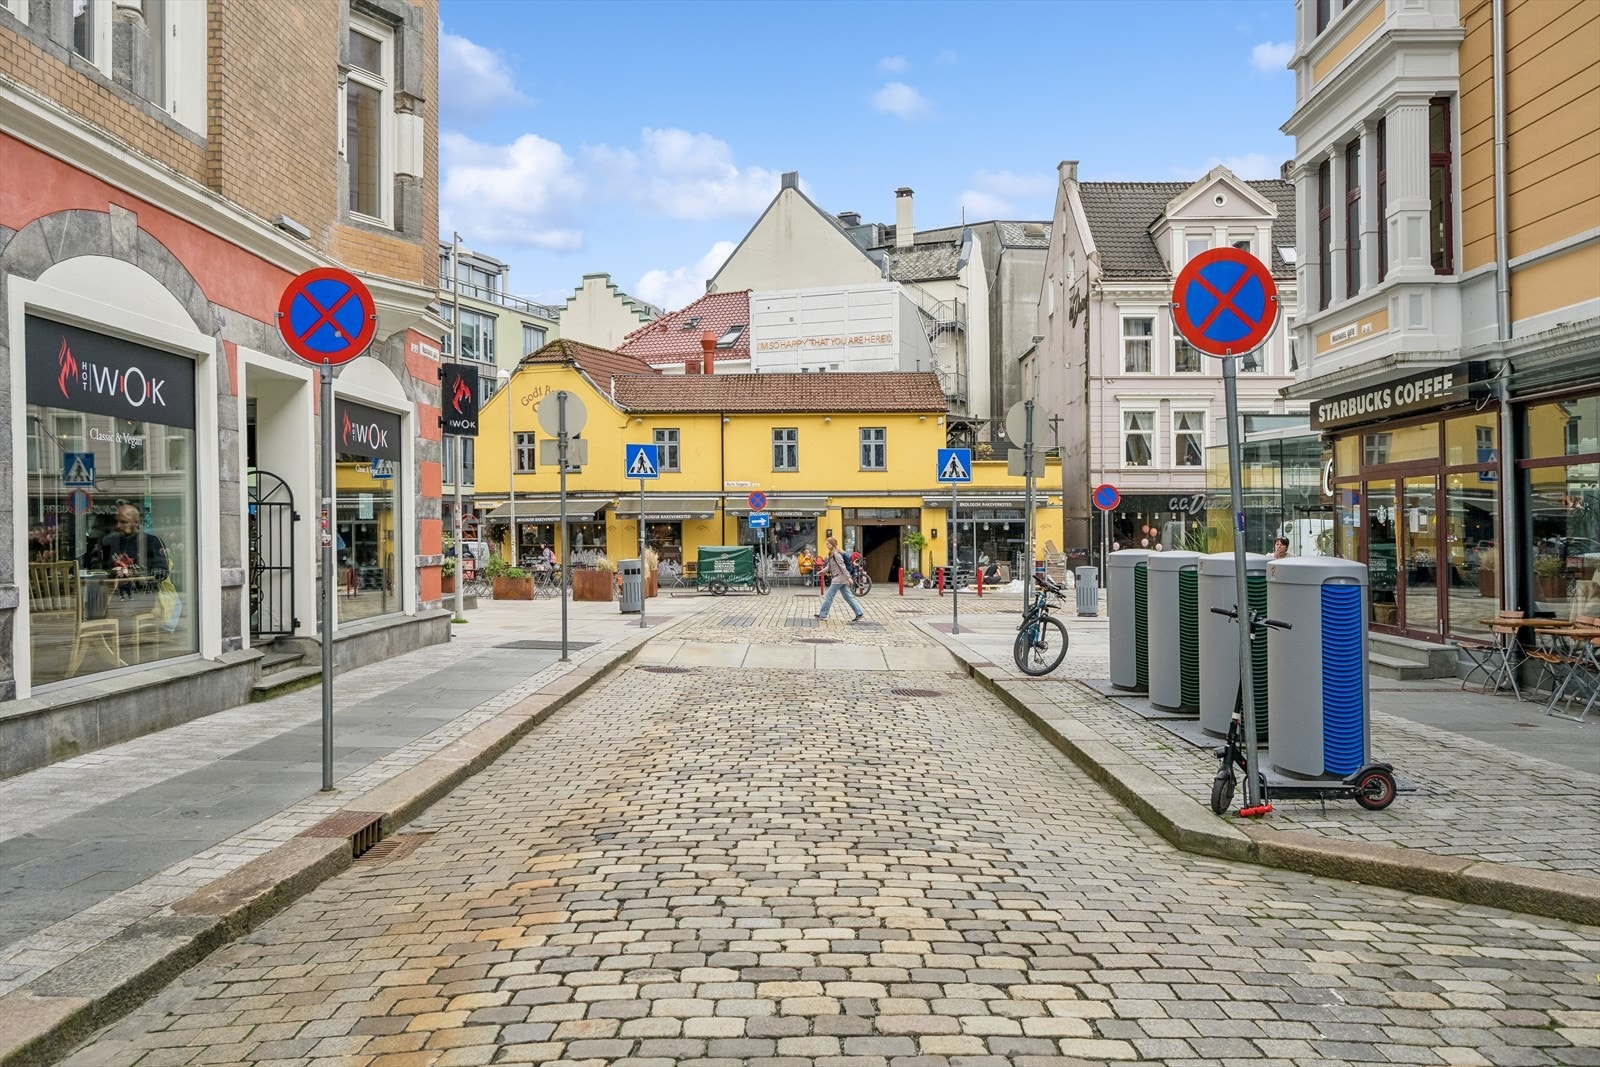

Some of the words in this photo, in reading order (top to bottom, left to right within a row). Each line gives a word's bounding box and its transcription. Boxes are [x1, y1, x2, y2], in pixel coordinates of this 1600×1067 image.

[769, 341, 779, 350] SO
[780, 338, 808, 349] HAPPY
[831, 336, 848, 346] YOU
[848, 336, 863, 345] ARE
[92, 363, 167, 407] WOK
[520, 386, 543, 407] Godt
[1318, 389, 1391, 423] STARBUCKS
[1394, 373, 1453, 406] COFFEE
[89, 427, 115, 442] Classic
[115, 433, 122, 443] &
[122, 432, 143, 449] Vegan
[356, 423, 389, 450] WOK
